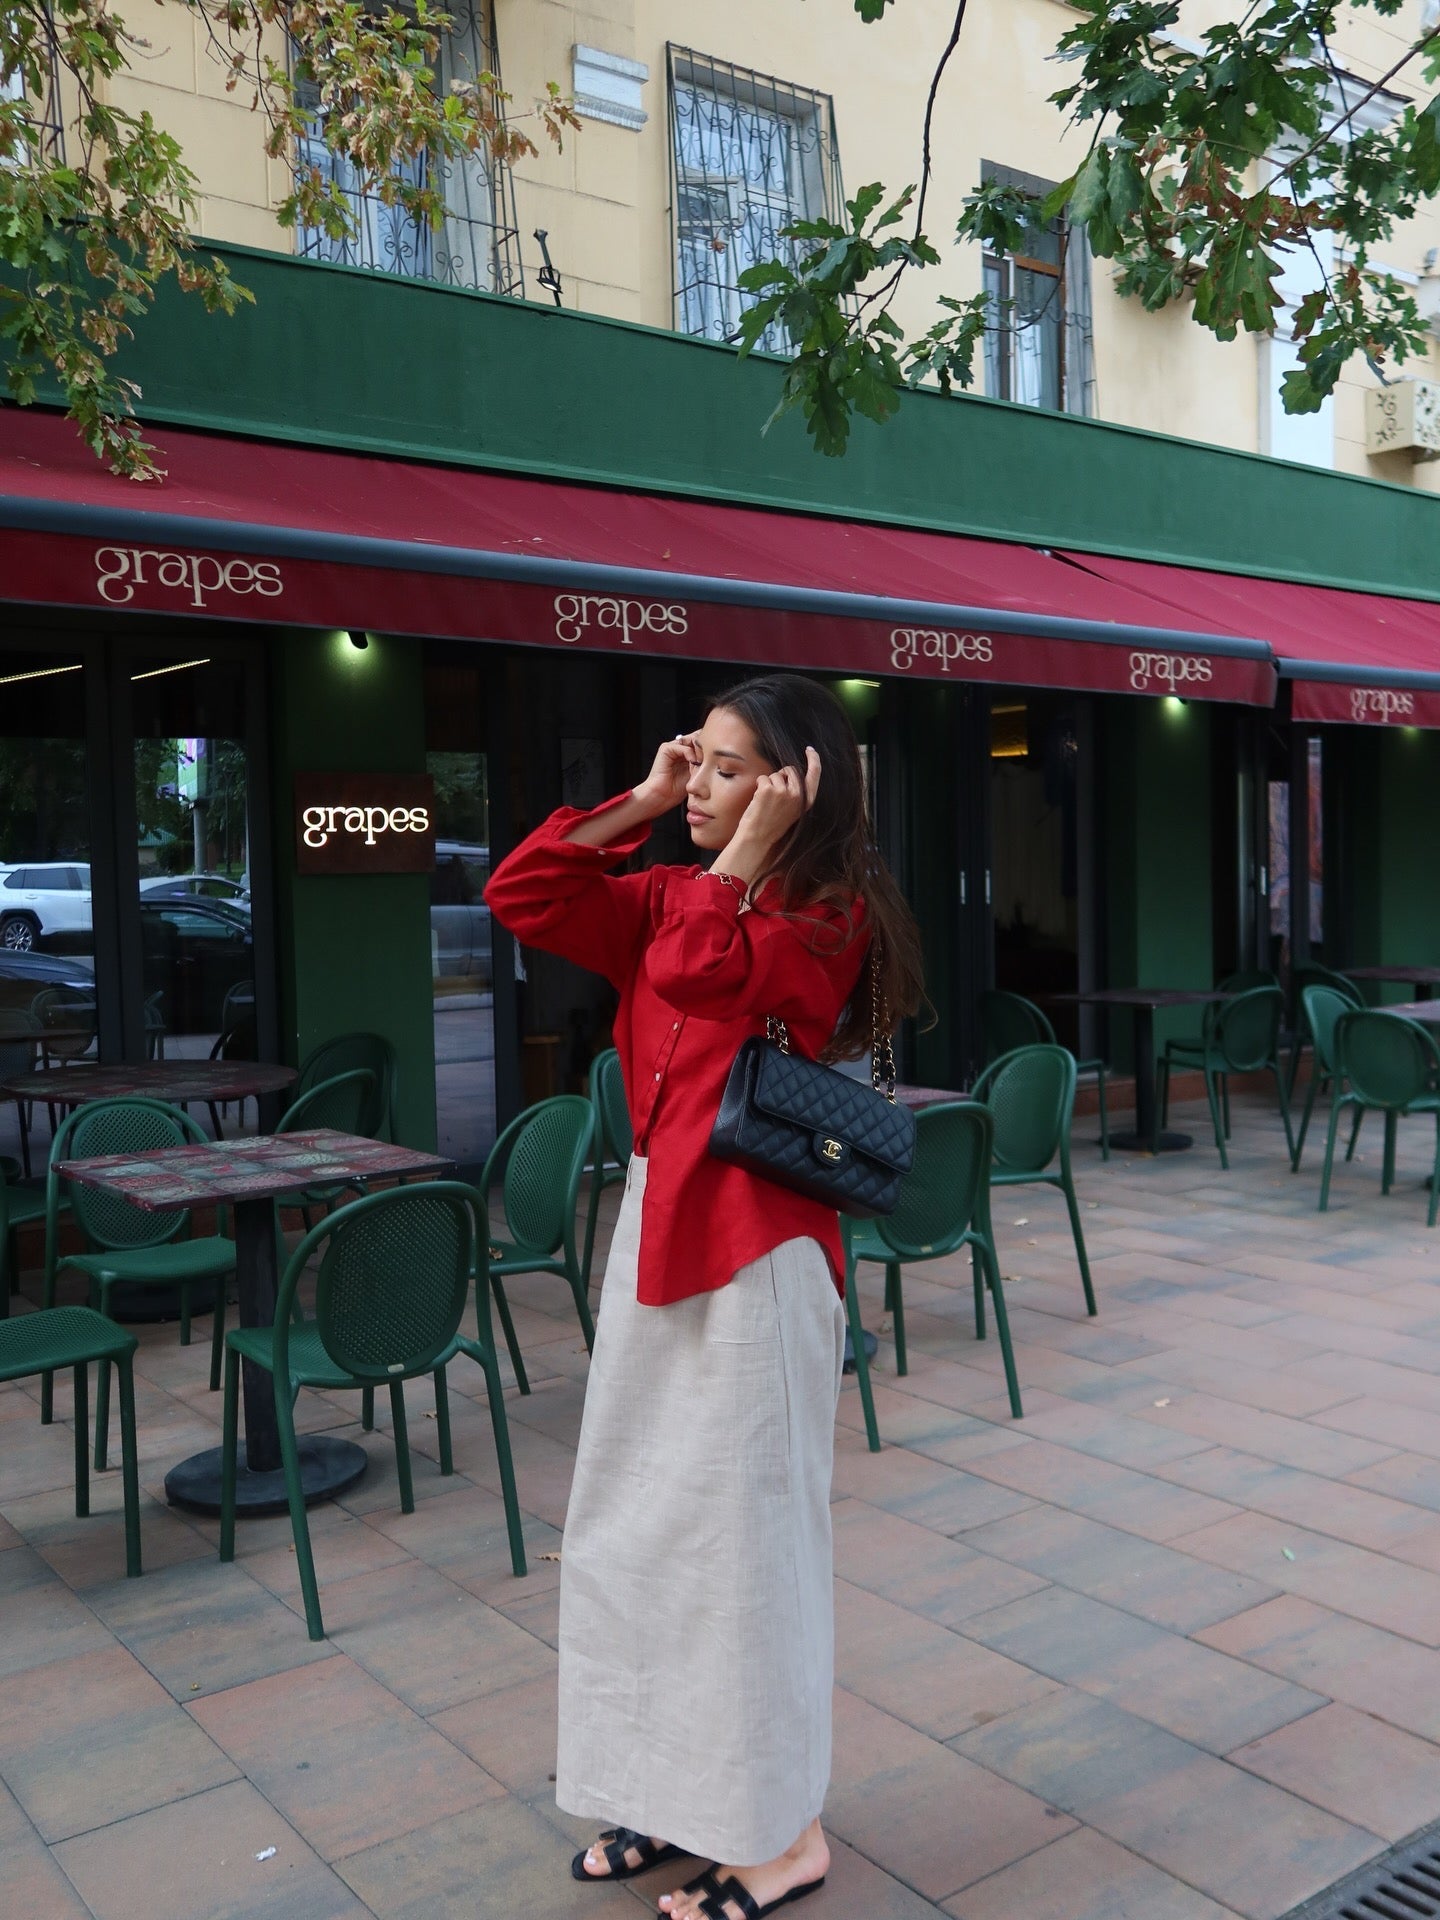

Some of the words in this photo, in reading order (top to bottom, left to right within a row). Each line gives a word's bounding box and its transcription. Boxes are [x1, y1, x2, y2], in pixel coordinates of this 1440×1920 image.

[95, 547, 283, 607] grapes
[554, 594, 688, 644] grapes
[890, 628, 993, 671] grapes
[1129, 653, 1212, 691] grapes
[1350, 688, 1414, 722] grapes
[302, 806, 429, 848] grapes
